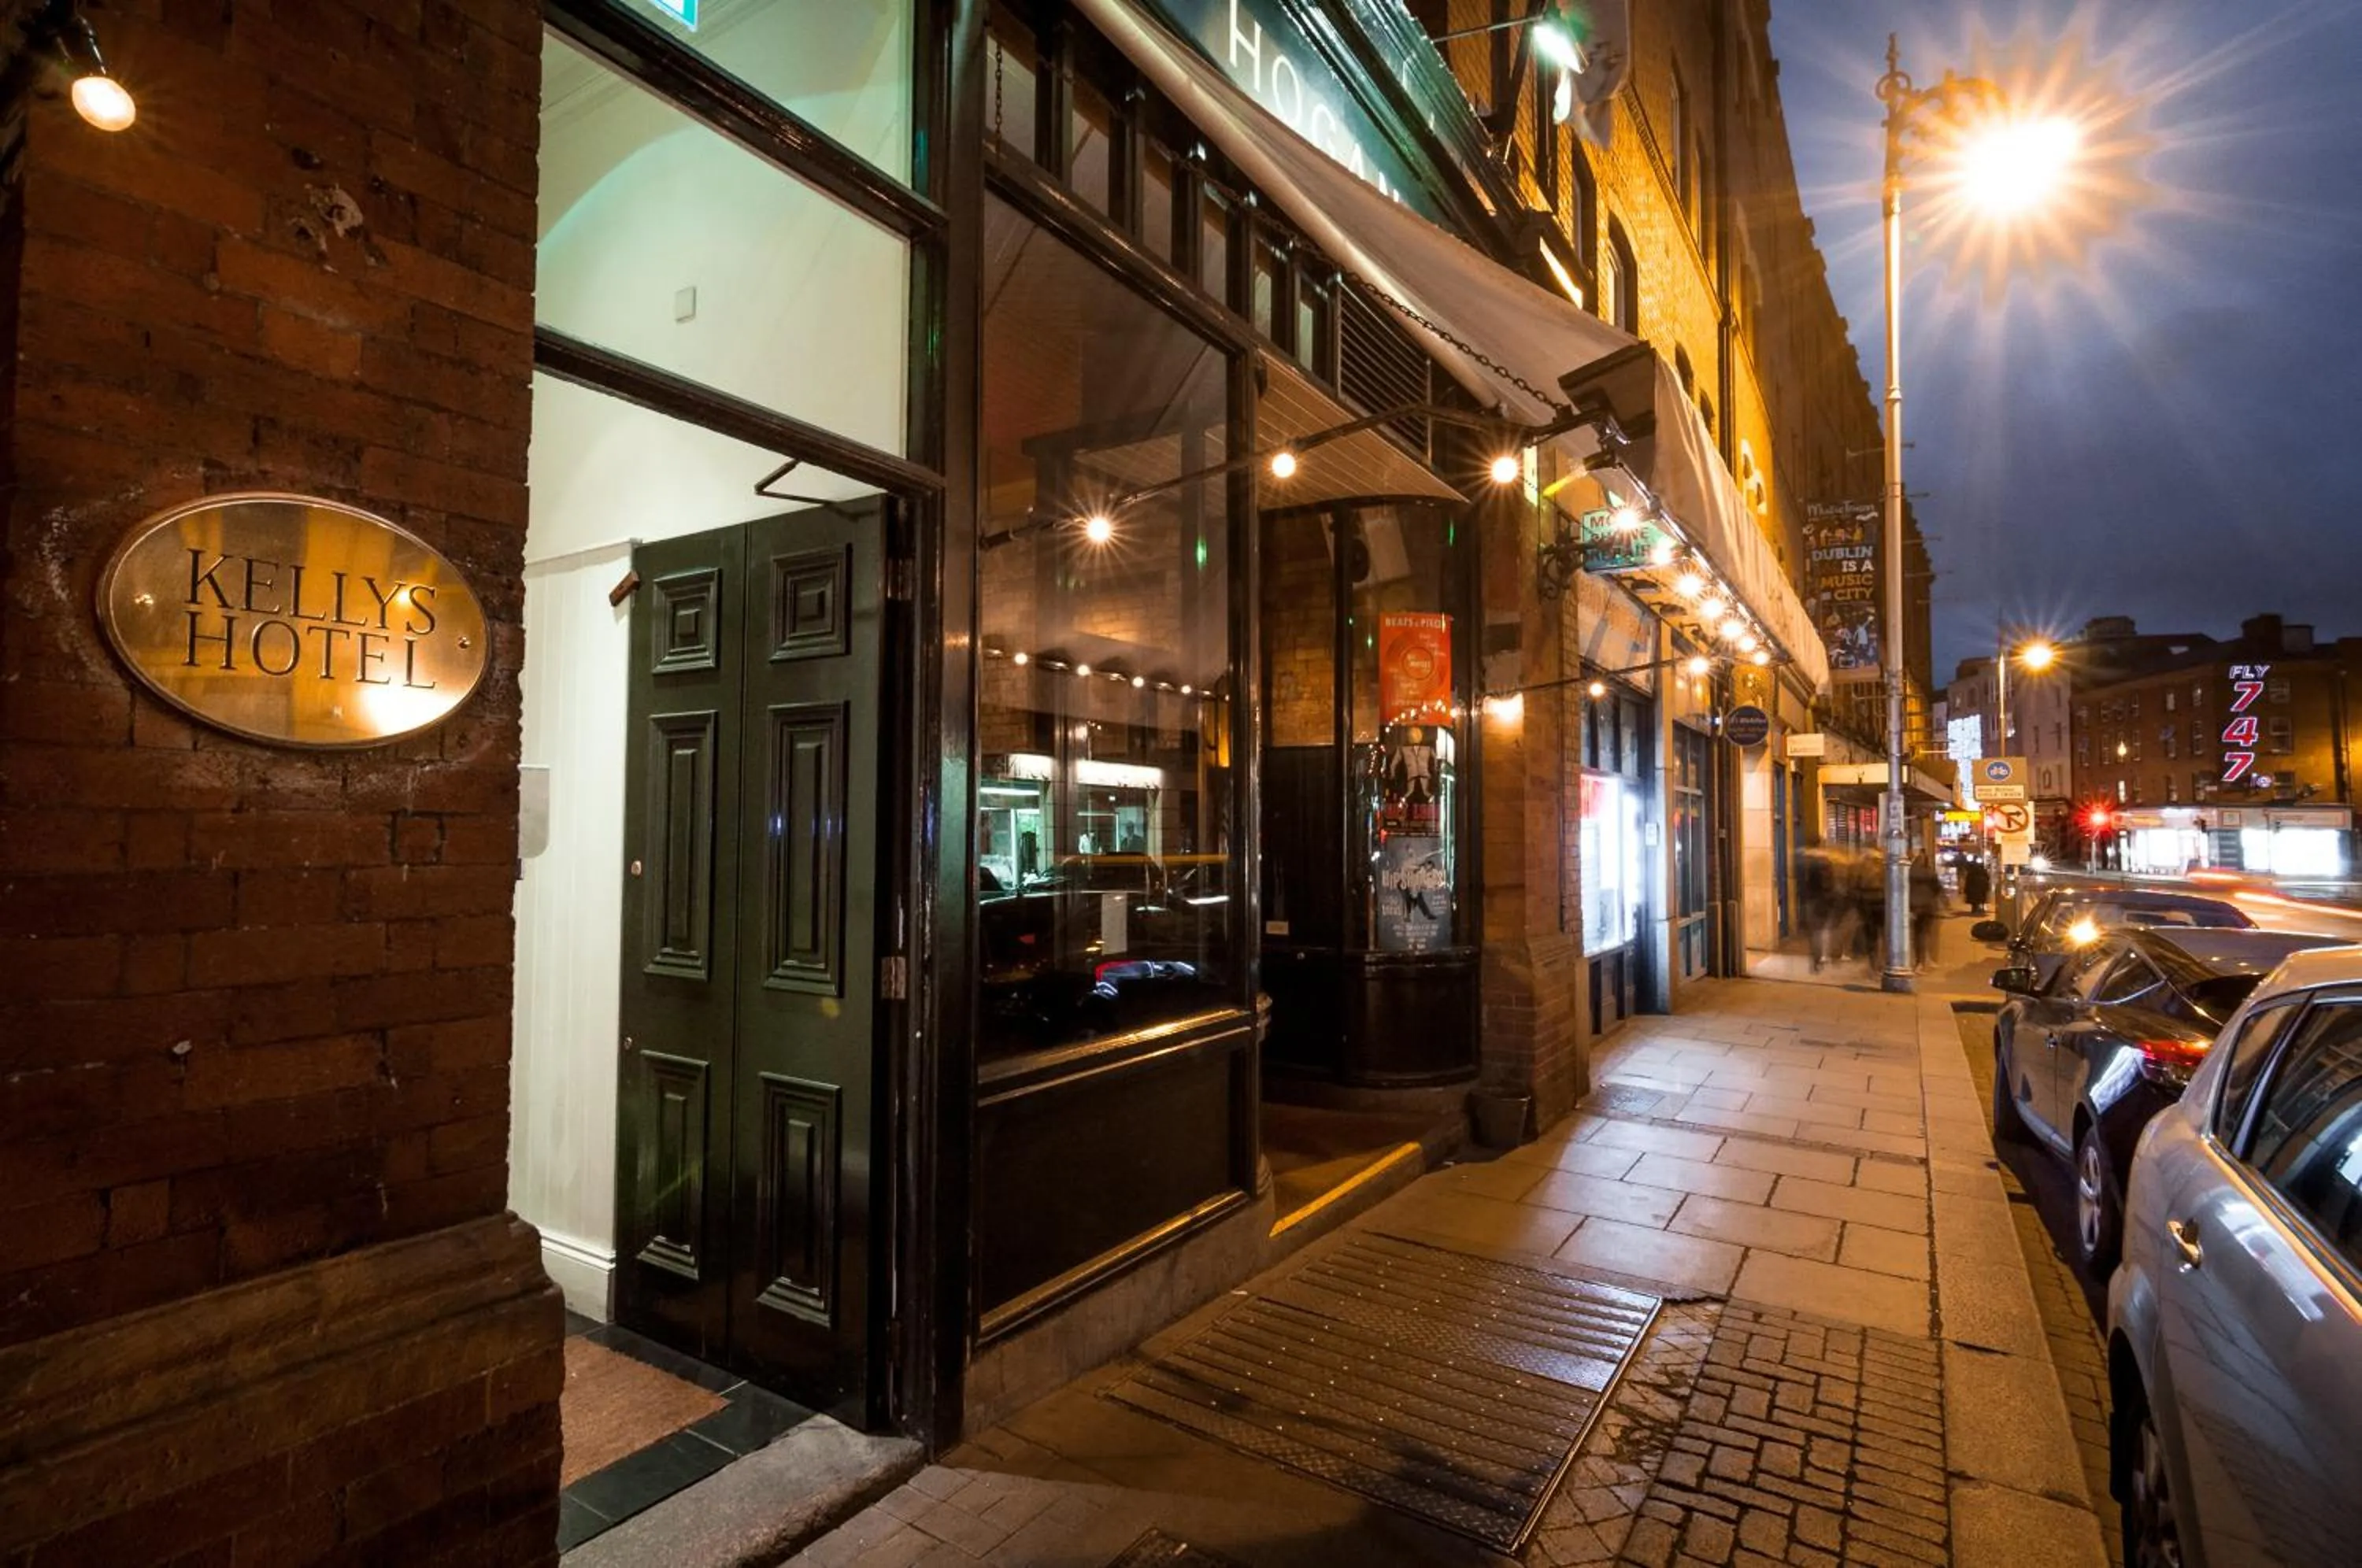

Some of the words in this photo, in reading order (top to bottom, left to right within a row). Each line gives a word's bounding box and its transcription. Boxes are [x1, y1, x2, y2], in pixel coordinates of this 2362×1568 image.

[1230, 0, 1399, 202] HOGA
[1812, 546, 1873, 560] DUBLIN
[1842, 560, 1858, 572] IS
[1860, 559, 1875, 572] A
[1822, 575, 1873, 587] MUSIC
[183, 548, 438, 635] KELLYS
[1834, 588, 1873, 600] CITY
[182, 611, 437, 689] HOTEL
[2229, 664, 2270, 679] FLY
[2221, 681, 2264, 782] 747
